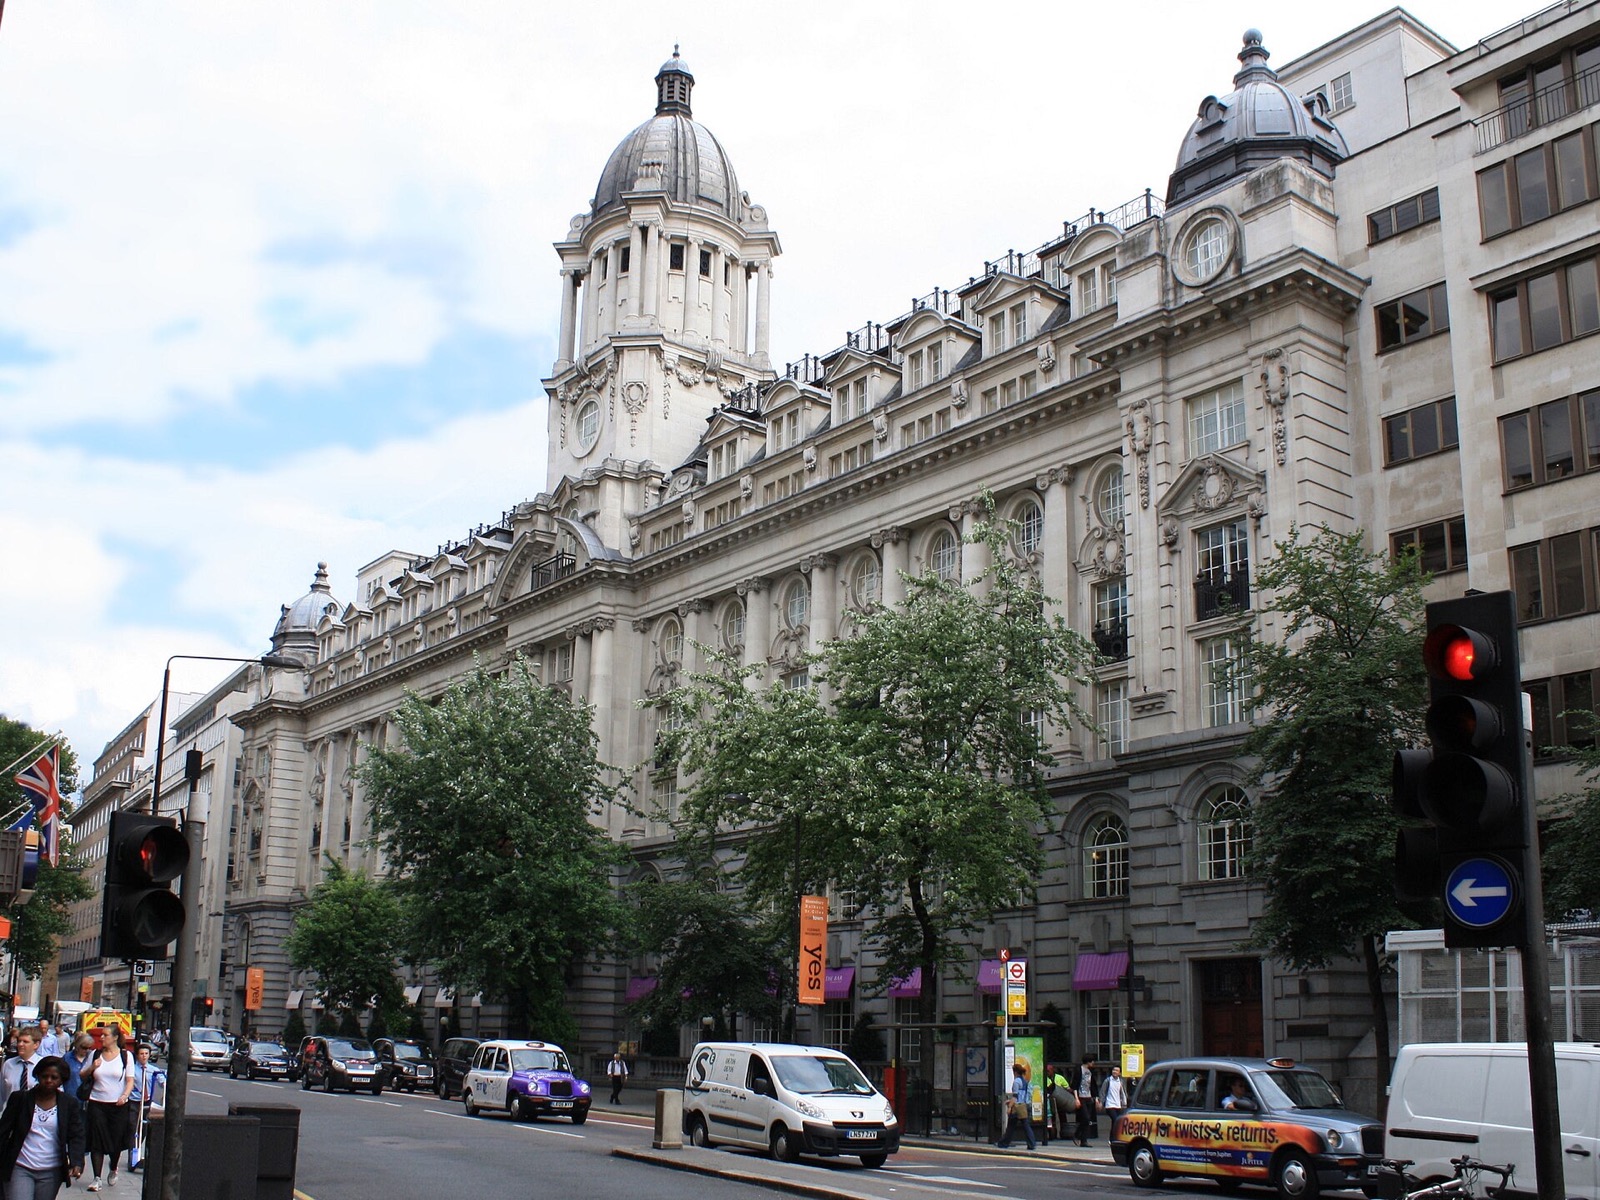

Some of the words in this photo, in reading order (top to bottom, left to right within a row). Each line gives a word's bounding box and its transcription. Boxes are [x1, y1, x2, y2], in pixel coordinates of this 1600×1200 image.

[1001, 949, 1007, 958] K
[804, 943, 822, 990] yes
[250, 986, 260, 1004] yes
[1121, 1117, 1152, 1138] Ready
[1156, 1118, 1171, 1138] for
[1175, 1120, 1210, 1140] twists
[1213, 1122, 1223, 1140] &
[1227, 1123, 1279, 1144] returns.
[1182, 1148, 1206, 1157] management
[1241, 1157, 1264, 1166] JUPITER
